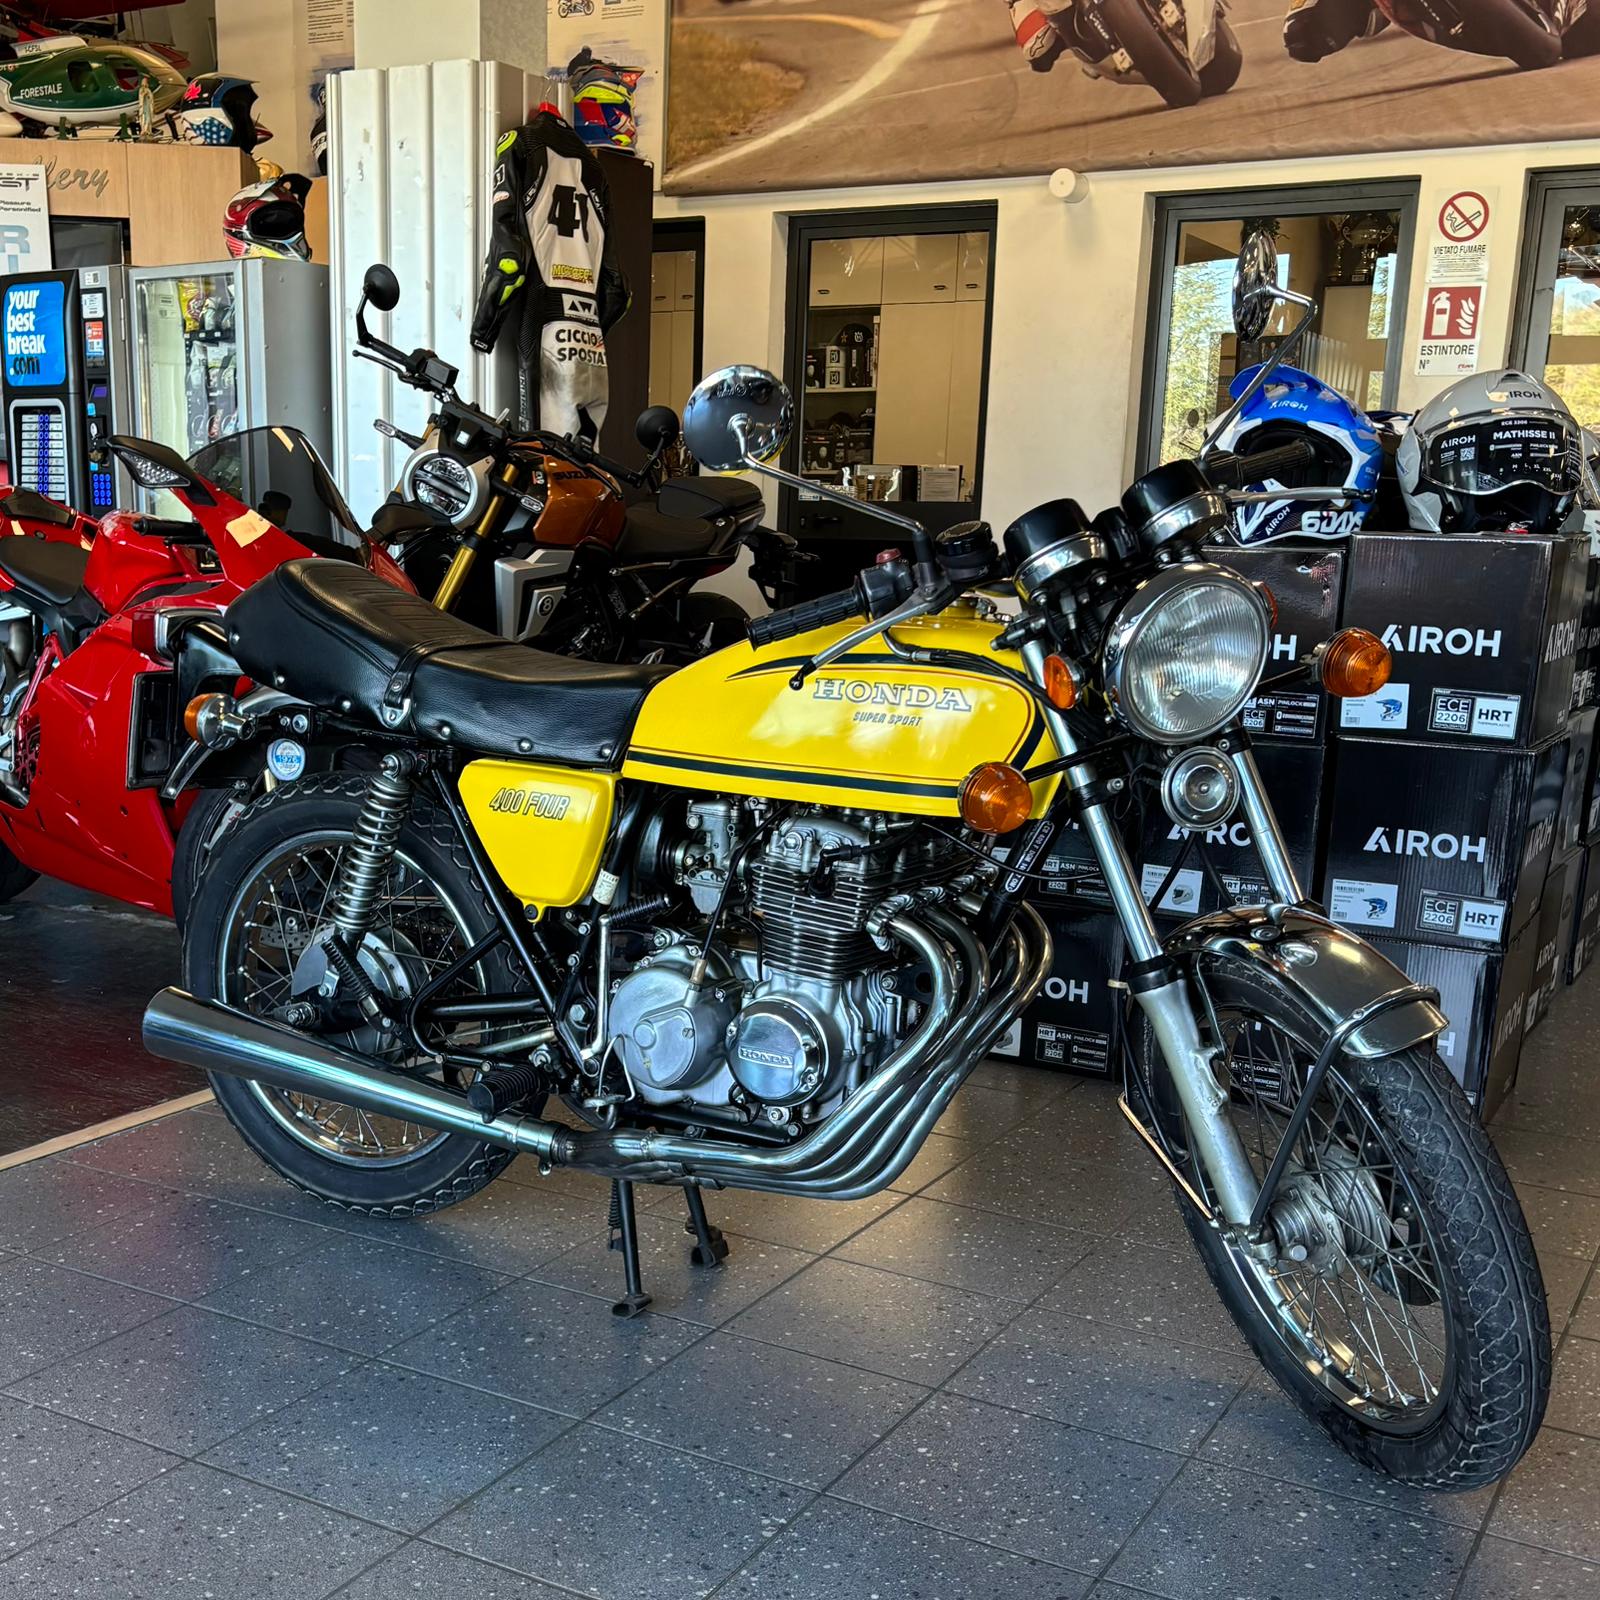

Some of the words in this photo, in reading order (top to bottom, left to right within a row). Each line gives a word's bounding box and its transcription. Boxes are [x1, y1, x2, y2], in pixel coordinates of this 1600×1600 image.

[20, 83, 63, 99] FORESTALE
[1433, 246, 1459, 255] VIETATO
[1459, 244, 1487, 254] FUMARE
[8, 289, 40, 313] your
[7, 311, 36, 333] best
[7, 333, 47, 355] break
[555, 328, 598, 346] CICCIO
[1420, 344, 1475, 356] ESTINTORE
[1507, 390, 1542, 400] IROH
[1440, 434, 1477, 449] AIROH
[1492, 429, 1548, 440] MATHISSE
[1264, 505, 1291, 536] AIROH
[1380, 624, 1502, 658] AIROH
[1543, 618, 1577, 664] AIROH
[812, 677, 972, 713] HONDA
[1257, 697, 1275, 706] ASN
[1437, 698, 1470, 713] ECE
[852, 711, 886, 724] SUPER
[887, 713, 924, 728] SPORT
[1244, 709, 1265, 719] ECE
[1436, 712, 1466, 723] 2206
[1478, 708, 1513, 722] HRT
[489, 786, 526, 814] 400
[522, 791, 571, 820] FOUR
[1363, 826, 1487, 863] AIROH
[1425, 899, 1457, 914] ECE
[1424, 912, 1453, 924] 2206
[1464, 911, 1499, 926] HRT
[1056, 1032, 1072, 1040] ASN
[740, 1047, 793, 1066] HONDA
